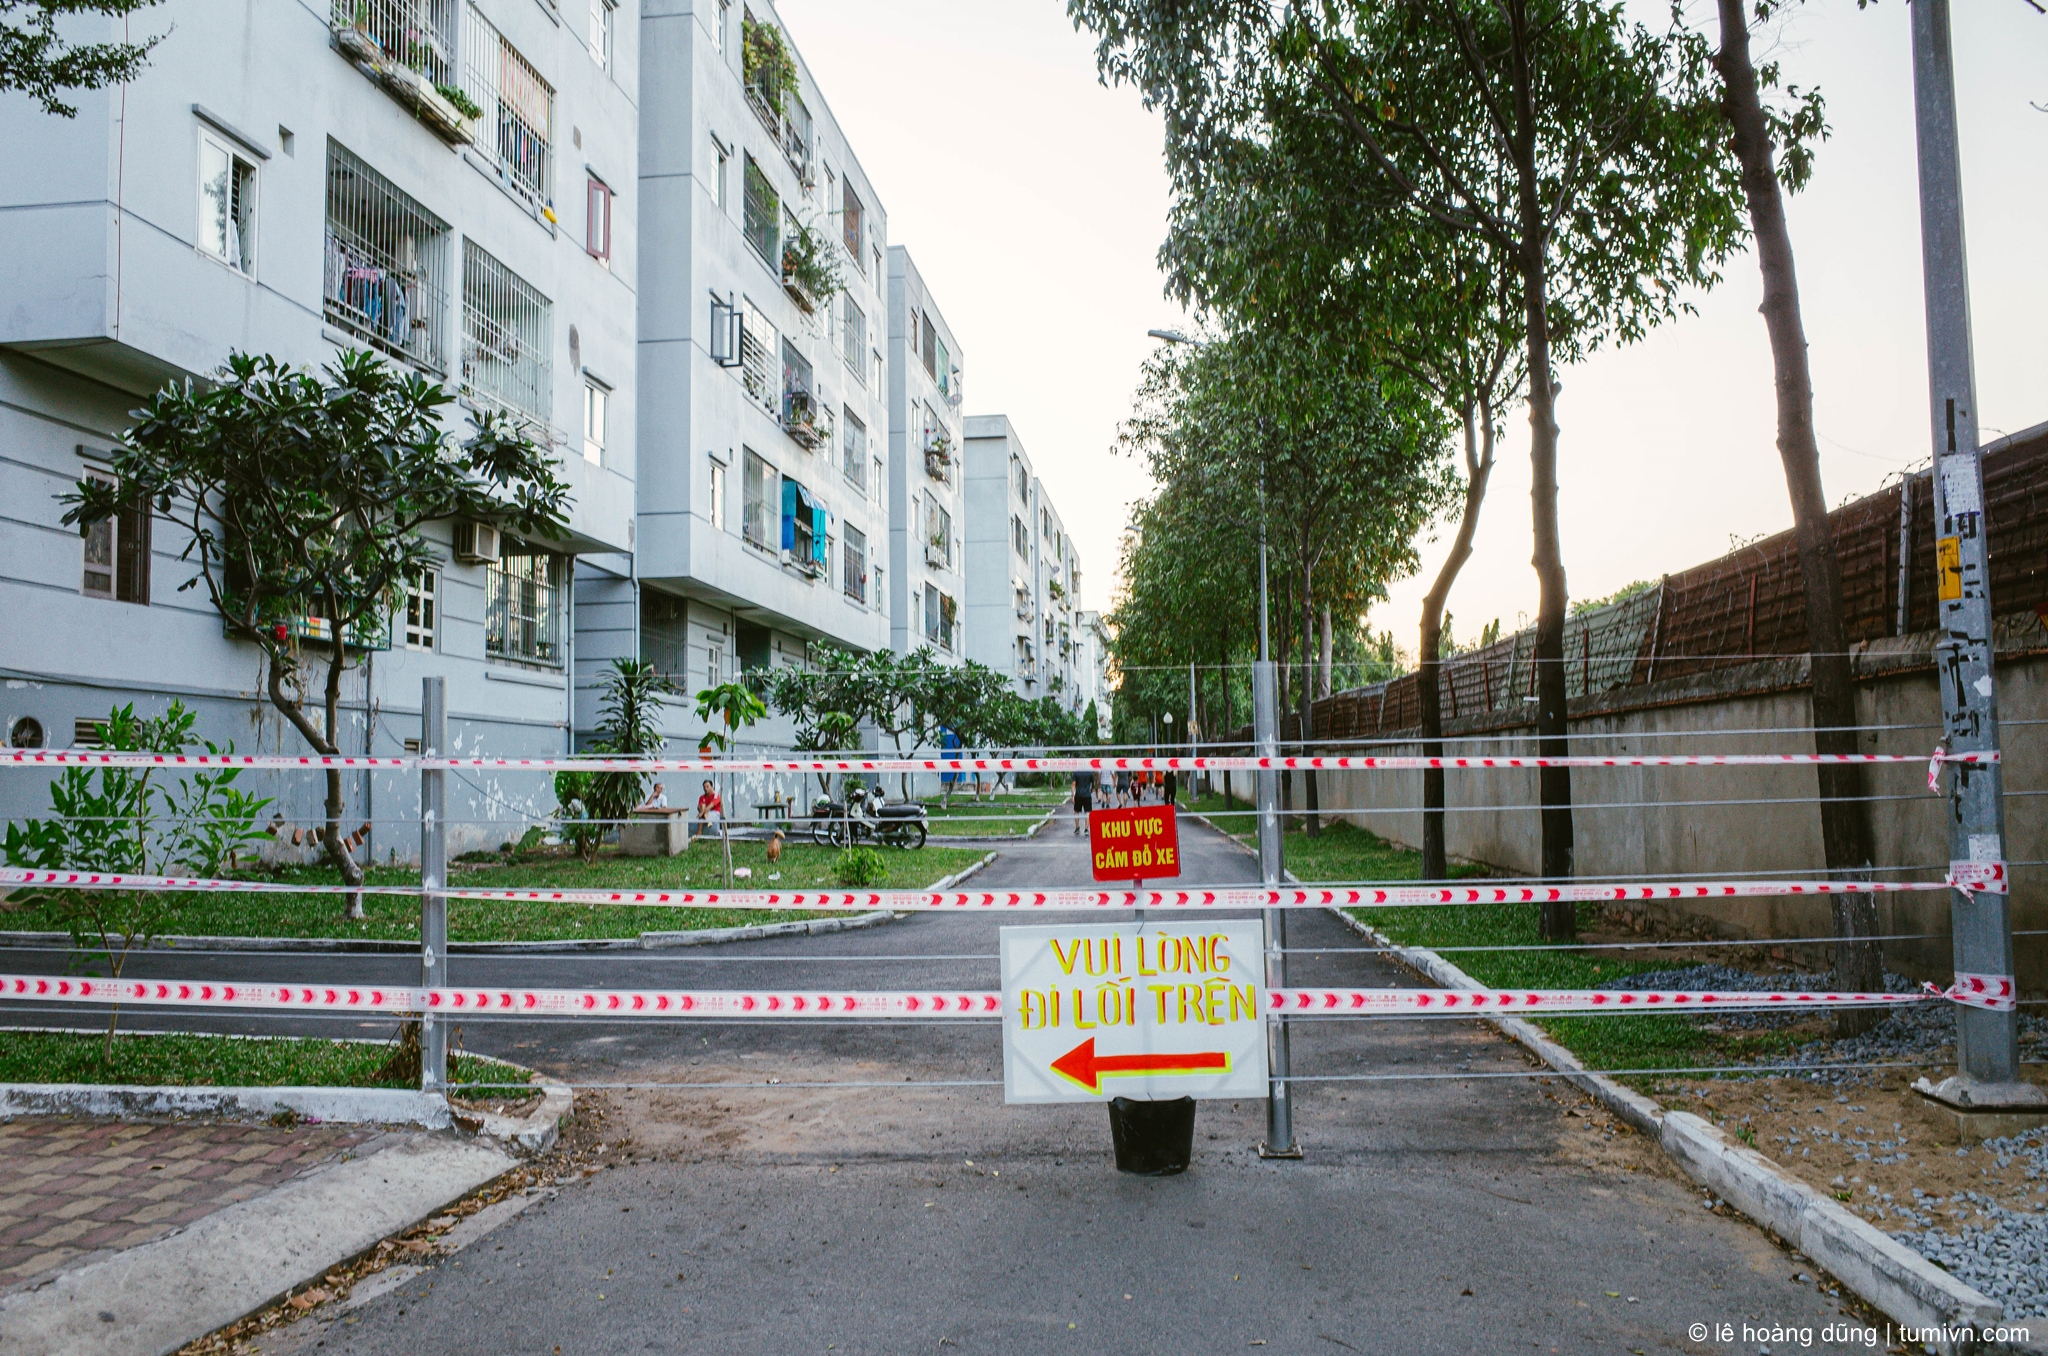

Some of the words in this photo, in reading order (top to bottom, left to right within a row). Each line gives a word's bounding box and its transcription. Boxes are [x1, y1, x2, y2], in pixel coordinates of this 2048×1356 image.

[1101, 820, 1130, 838] KHU
[1134, 817, 1163, 839] VỰC
[1095, 846, 1129, 869] CẤM
[1132, 844, 1152, 867] ĐỖ
[1156, 848, 1175, 865] XE
[1050, 932, 1122, 976] VUI
[1136, 931, 1231, 976] LÒNG
[1018, 984, 1060, 1030] ĐI
[1072, 977, 1135, 1029] LỐI
[1147, 977, 1257, 1025] TRÊN
